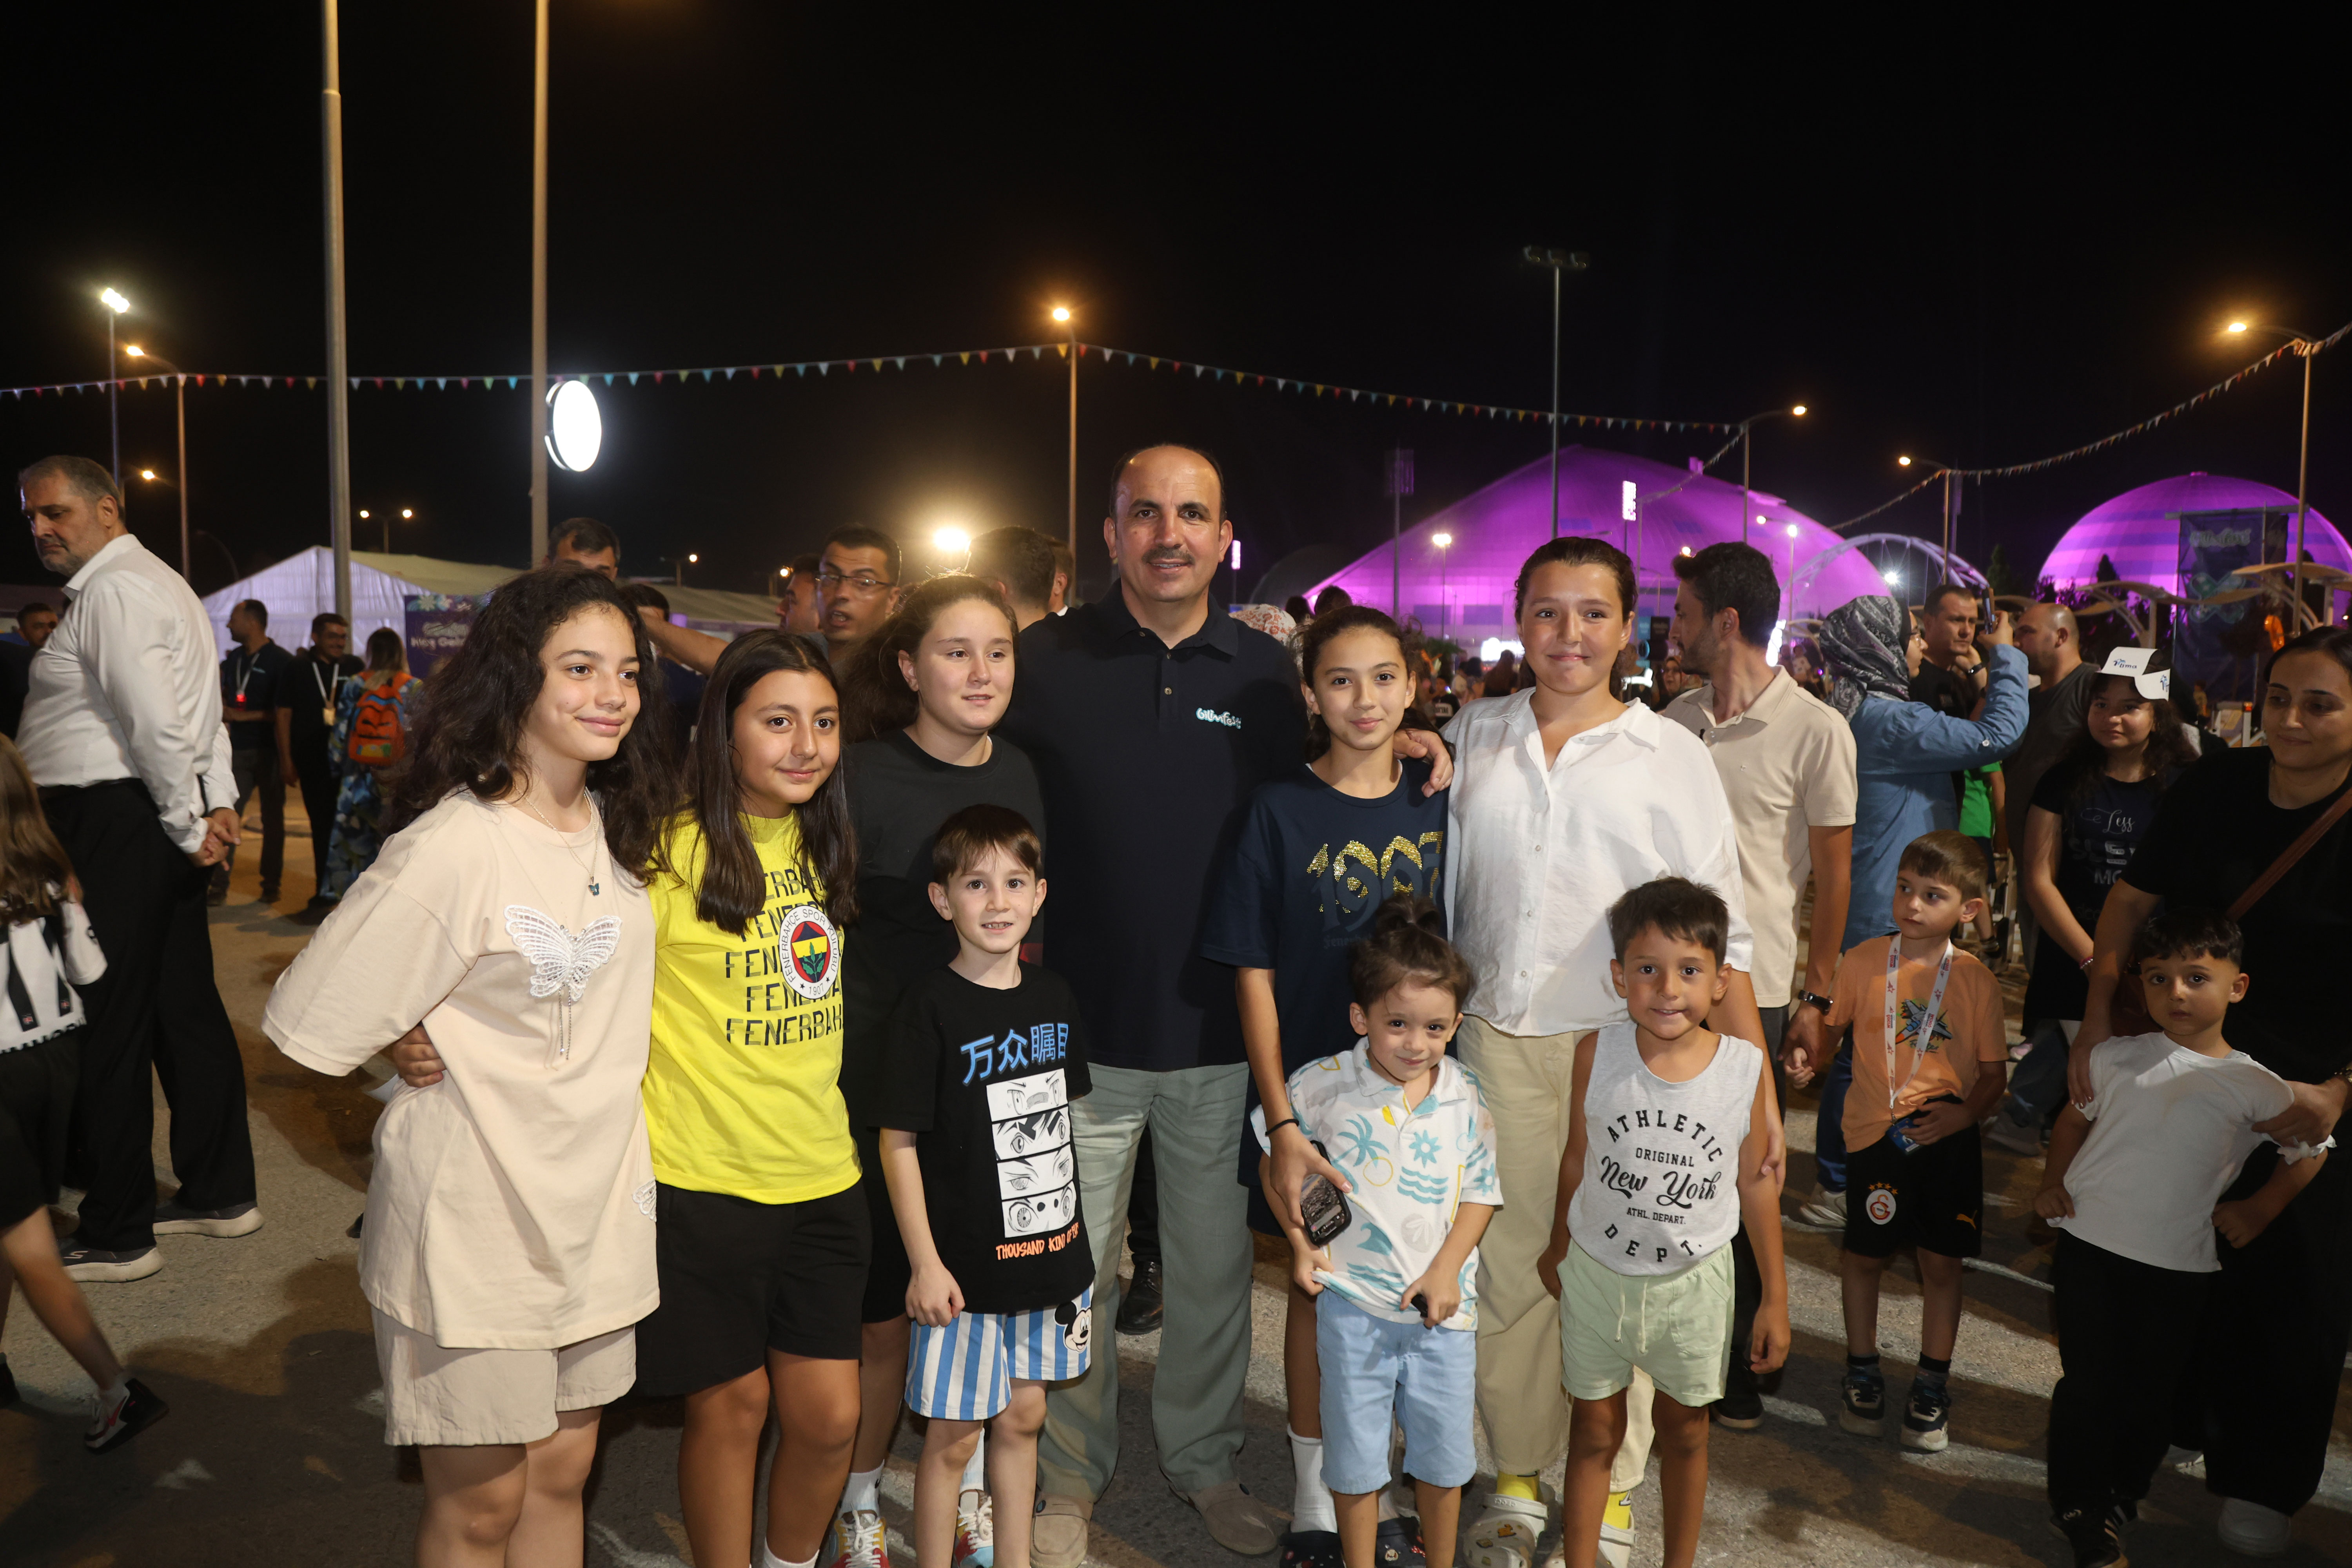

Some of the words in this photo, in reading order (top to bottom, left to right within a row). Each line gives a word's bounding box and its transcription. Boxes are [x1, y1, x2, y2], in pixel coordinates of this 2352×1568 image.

[781, 911, 800, 983] FENERBAHÇE
[802, 908, 826, 926] SPOR
[809, 983, 824, 996] 1907
[960, 1022, 1069, 1087] 万众瞩目
[1607, 1109, 1723, 1162] ATHLETIC
[1635, 1147, 1695, 1167] ORIGINAL
[1601, 1156, 1649, 1200] New
[1656, 1171, 1722, 1209] York
[1626, 1207, 1650, 1220] ATHL.
[1652, 1212, 1686, 1225] DEPART.
[995, 1239, 1045, 1260] THOUSAND
[1048, 1233, 1065, 1252] KIND
[1604, 1223, 1702, 1263] DEPT.
